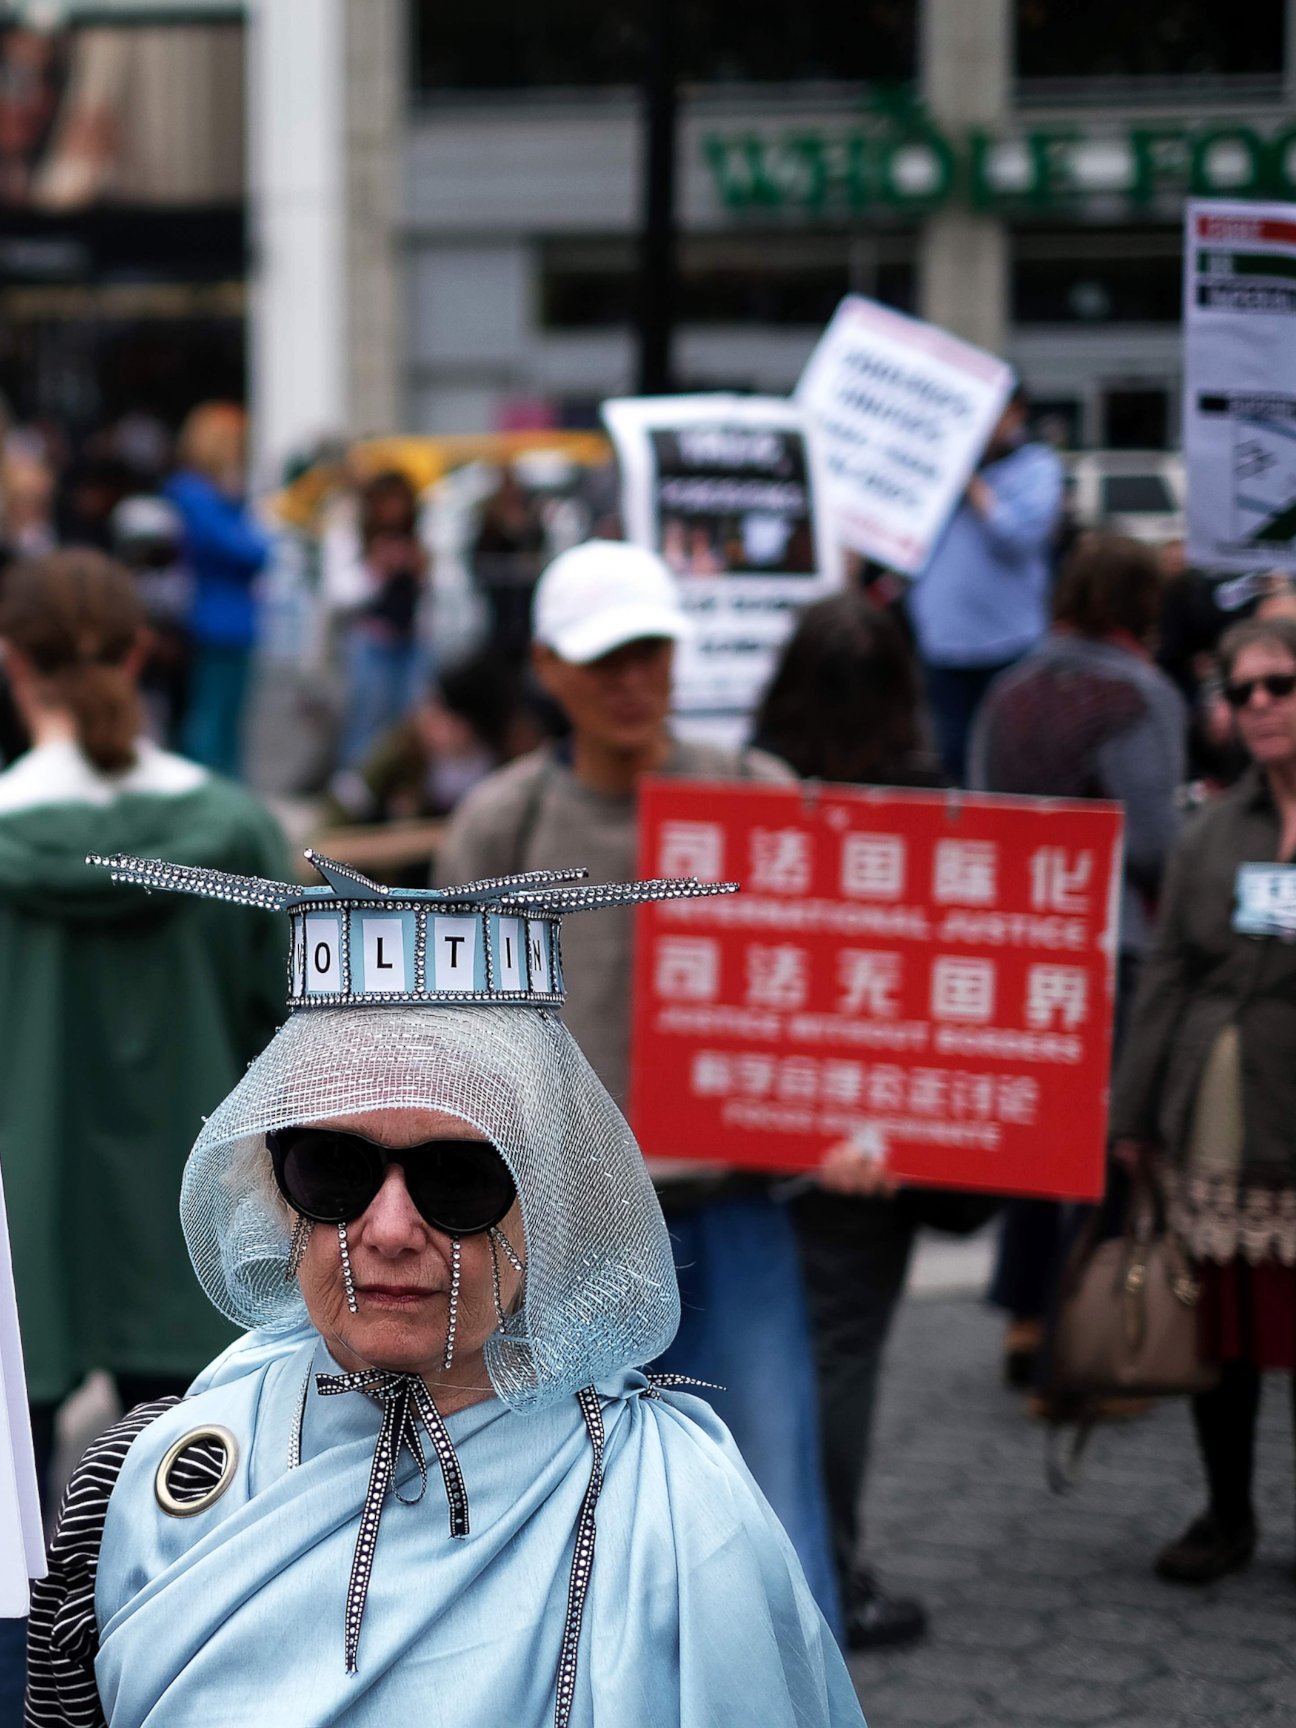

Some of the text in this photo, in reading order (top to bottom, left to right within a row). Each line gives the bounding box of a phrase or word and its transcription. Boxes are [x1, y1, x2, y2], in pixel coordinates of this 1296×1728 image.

[706, 124, 1296, 208] WHOLE FO
[658, 820, 1094, 913] 司法国际化
[940, 908, 1089, 951] JUSTICE
[654, 934, 1090, 1031] 司法无国界
[658, 1003, 1083, 1064] JUSTICE WITHOUT BORDERS
